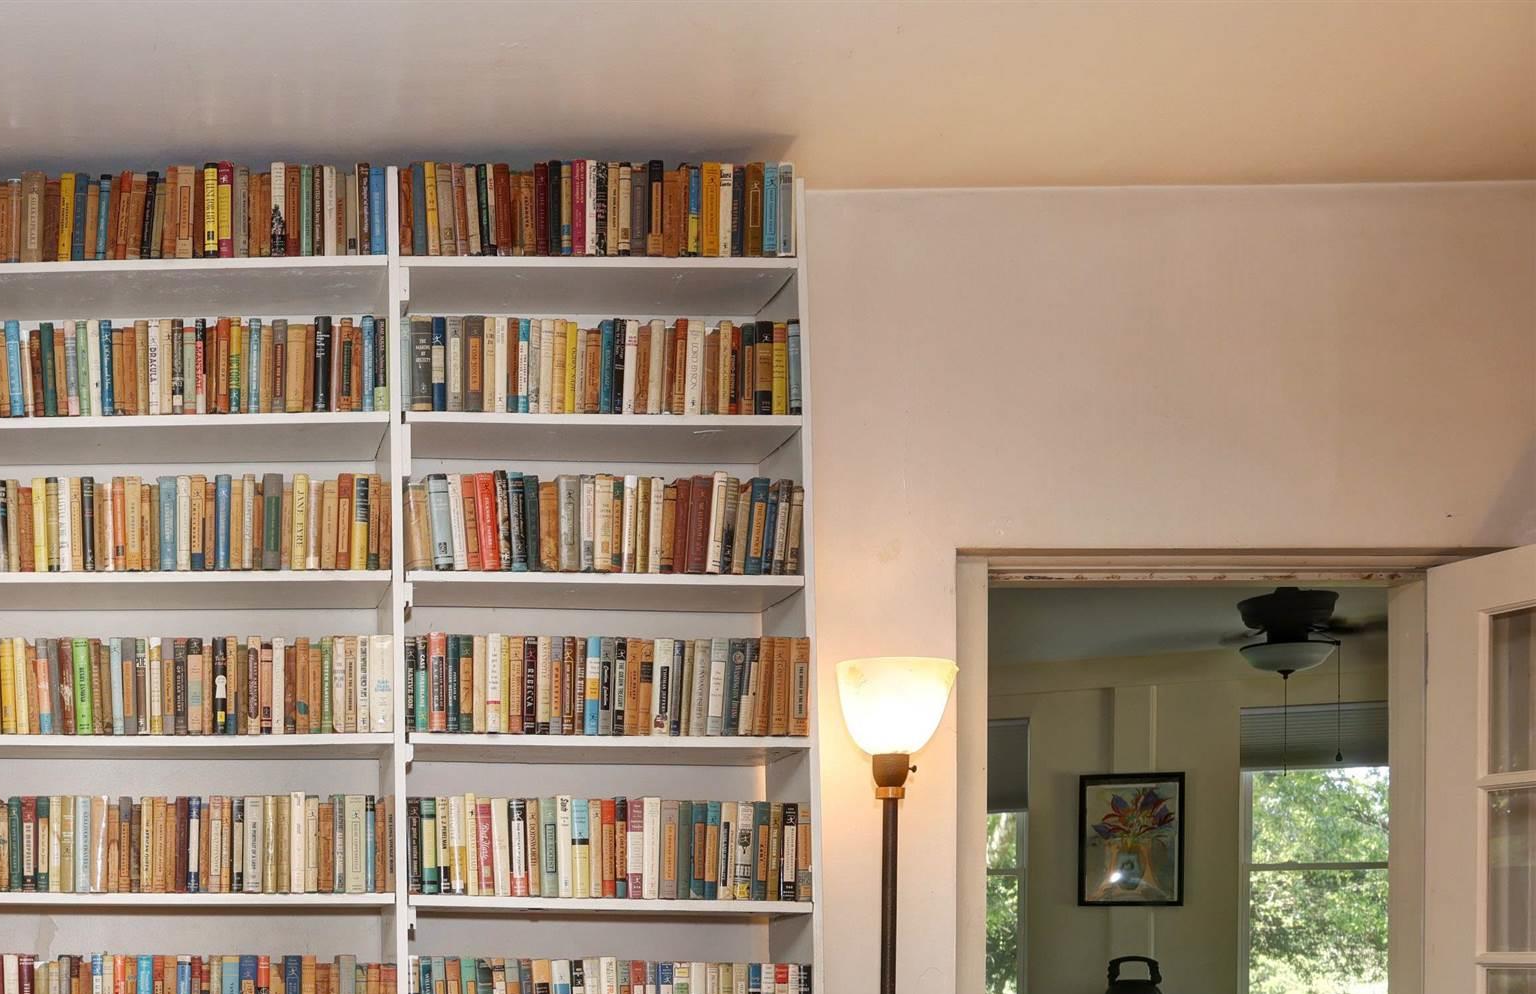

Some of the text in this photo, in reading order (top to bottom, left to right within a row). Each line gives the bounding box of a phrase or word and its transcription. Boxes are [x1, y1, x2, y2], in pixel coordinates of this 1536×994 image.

[206, 183, 215, 225] LUST FOR LIFE
[230, 354, 240, 389] VICTORY
[691, 344, 700, 390] LORD BYRON
[295, 490, 304, 548] JANE EYRE
[547, 828, 555, 869] THE EGOIST
